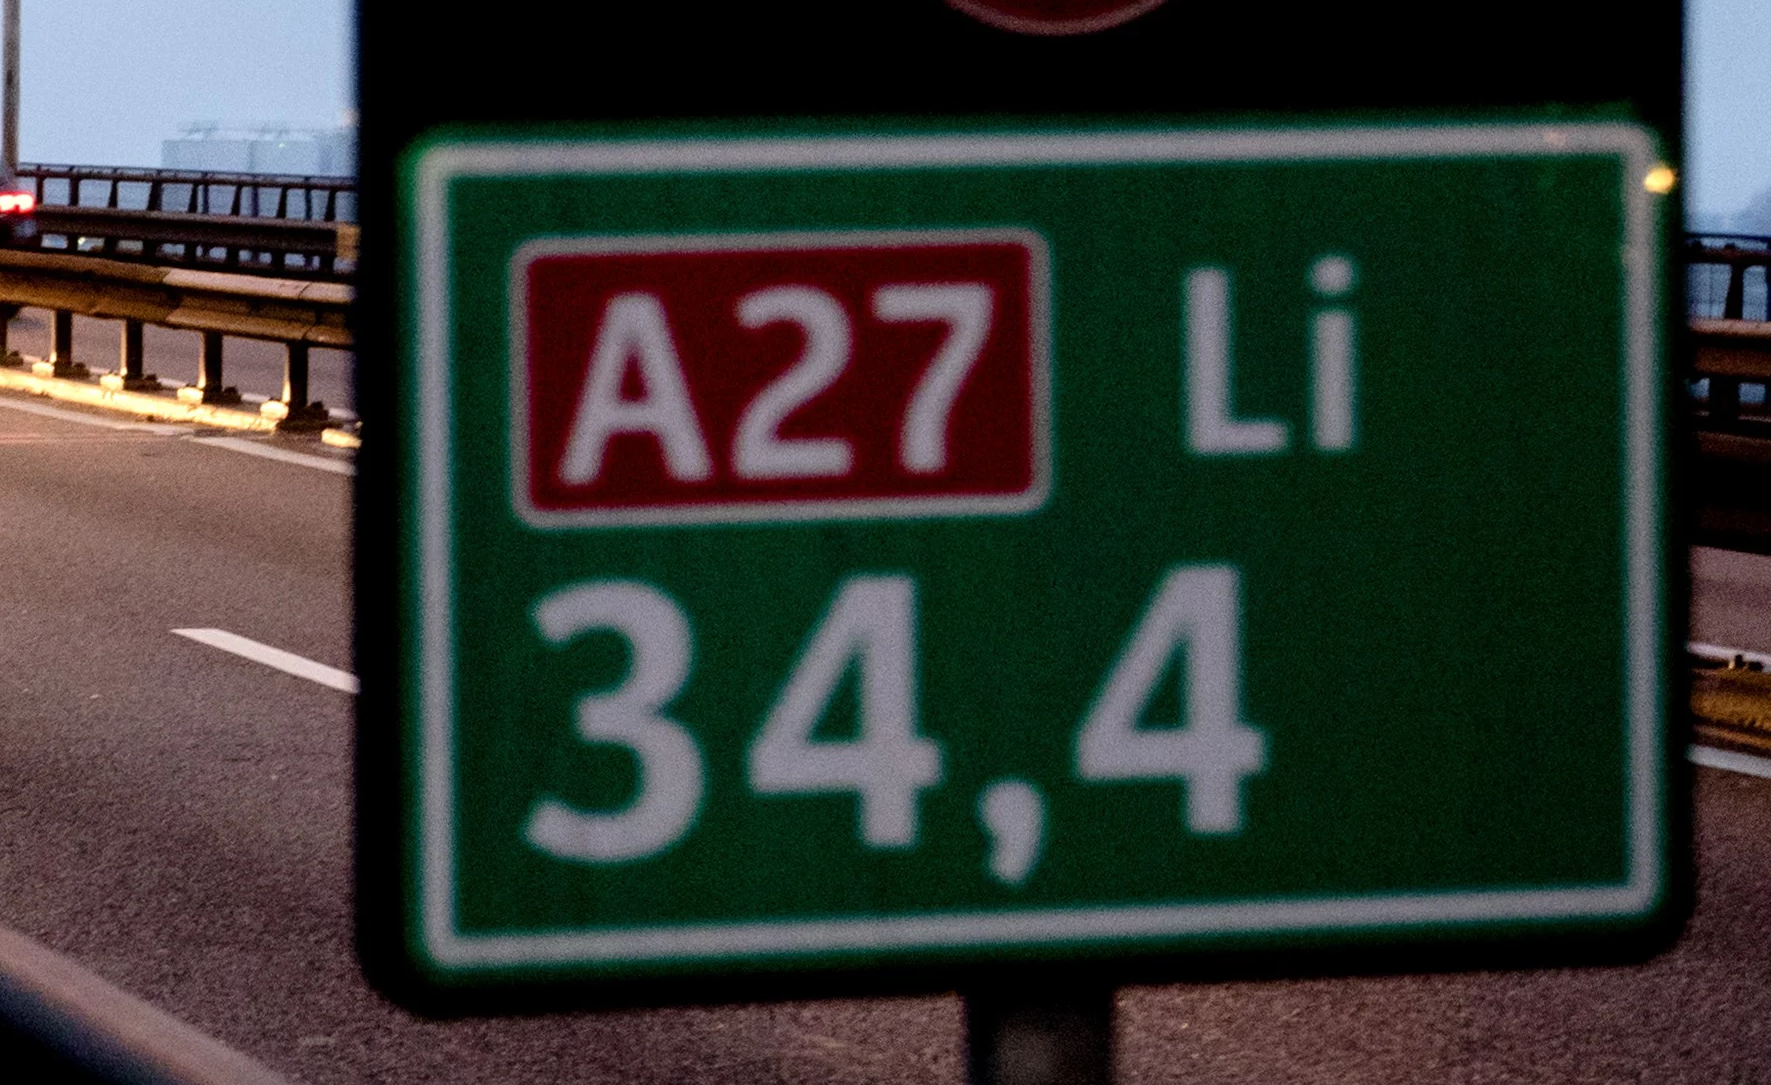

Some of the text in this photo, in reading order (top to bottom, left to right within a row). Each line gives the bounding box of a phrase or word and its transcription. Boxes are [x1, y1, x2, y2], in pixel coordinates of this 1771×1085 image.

[556, 255, 1358, 486] A27 Li
[525, 563, 1272, 886] 34,4
